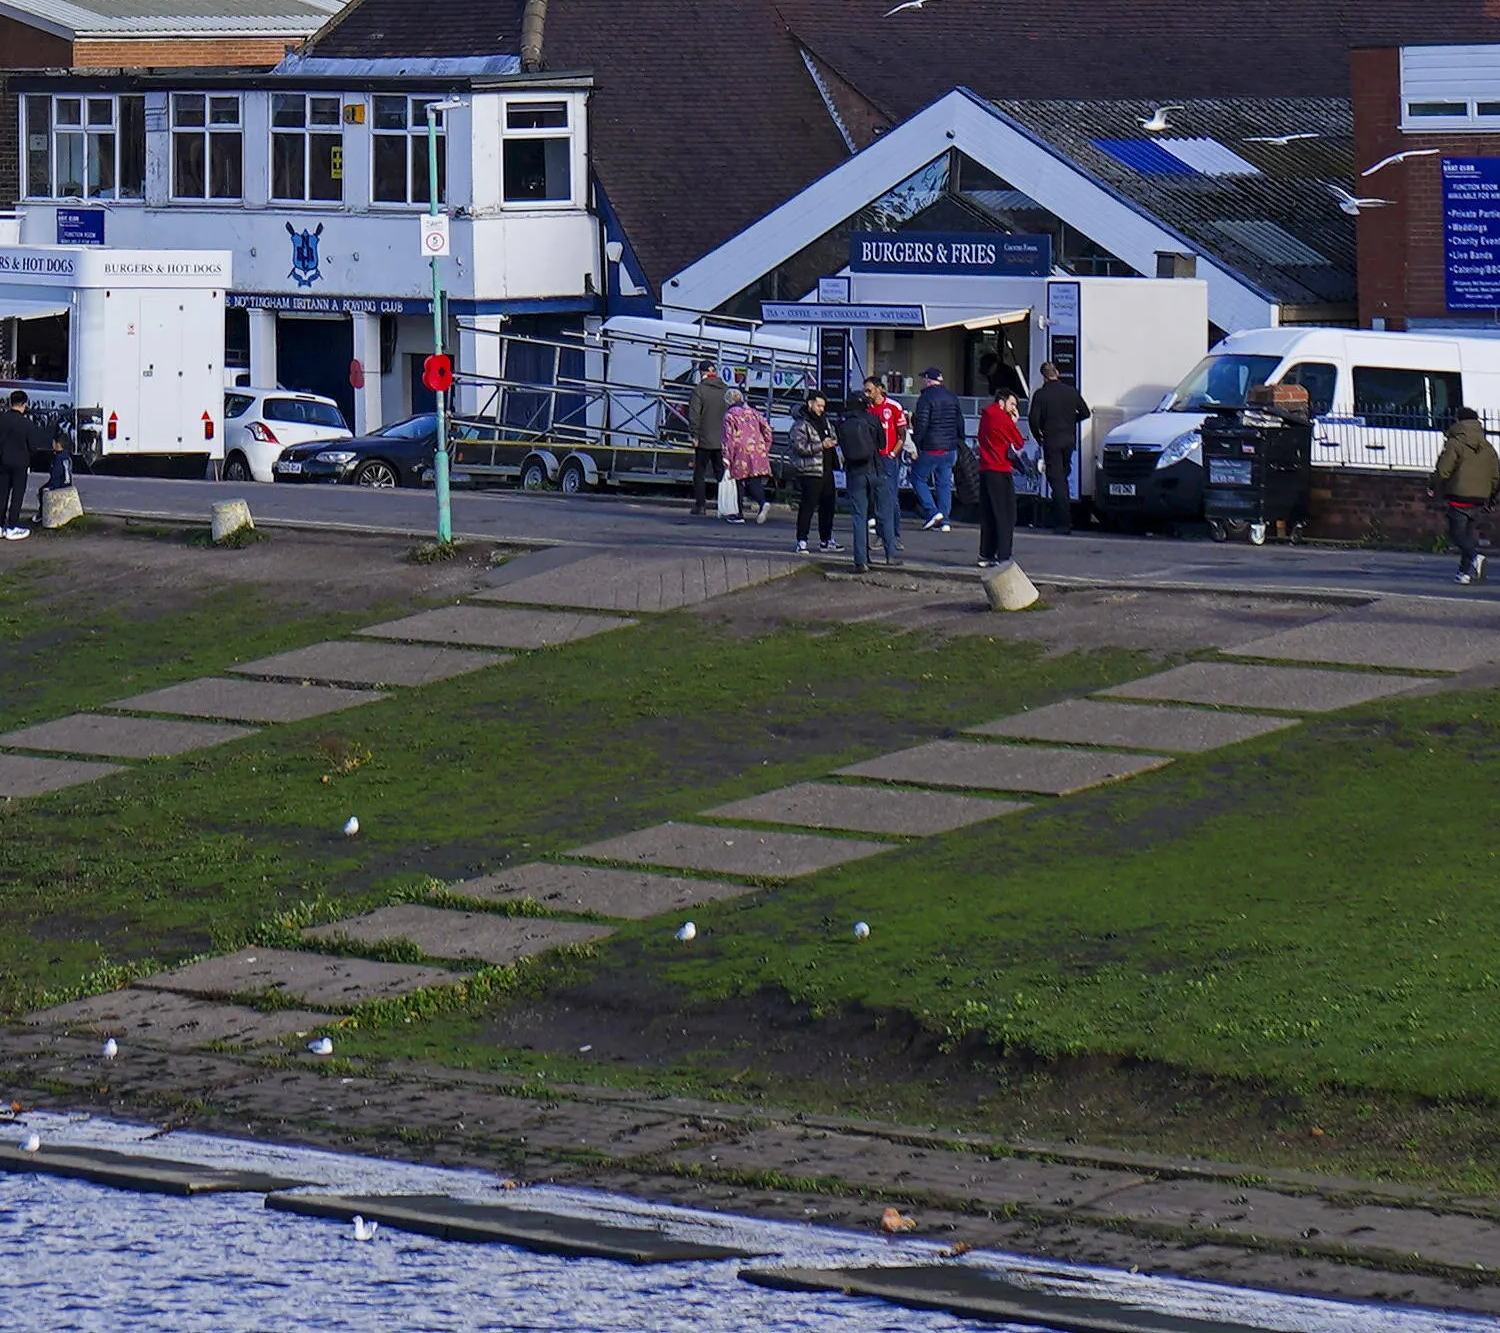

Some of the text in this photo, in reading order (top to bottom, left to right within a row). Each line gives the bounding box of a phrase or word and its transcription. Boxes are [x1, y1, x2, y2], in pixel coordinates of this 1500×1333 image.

[861, 240, 934, 264] BURGERS
[935, 242, 949, 264] &
[951, 242, 997, 265] FRIES
[11, 258, 20, 270] &
[22, 257, 44, 271] HOT
[46, 257, 74, 273] DOGS
[104, 263, 223, 274] BURGERS & HOT DOGS
[380, 300, 404, 313] CLUB
